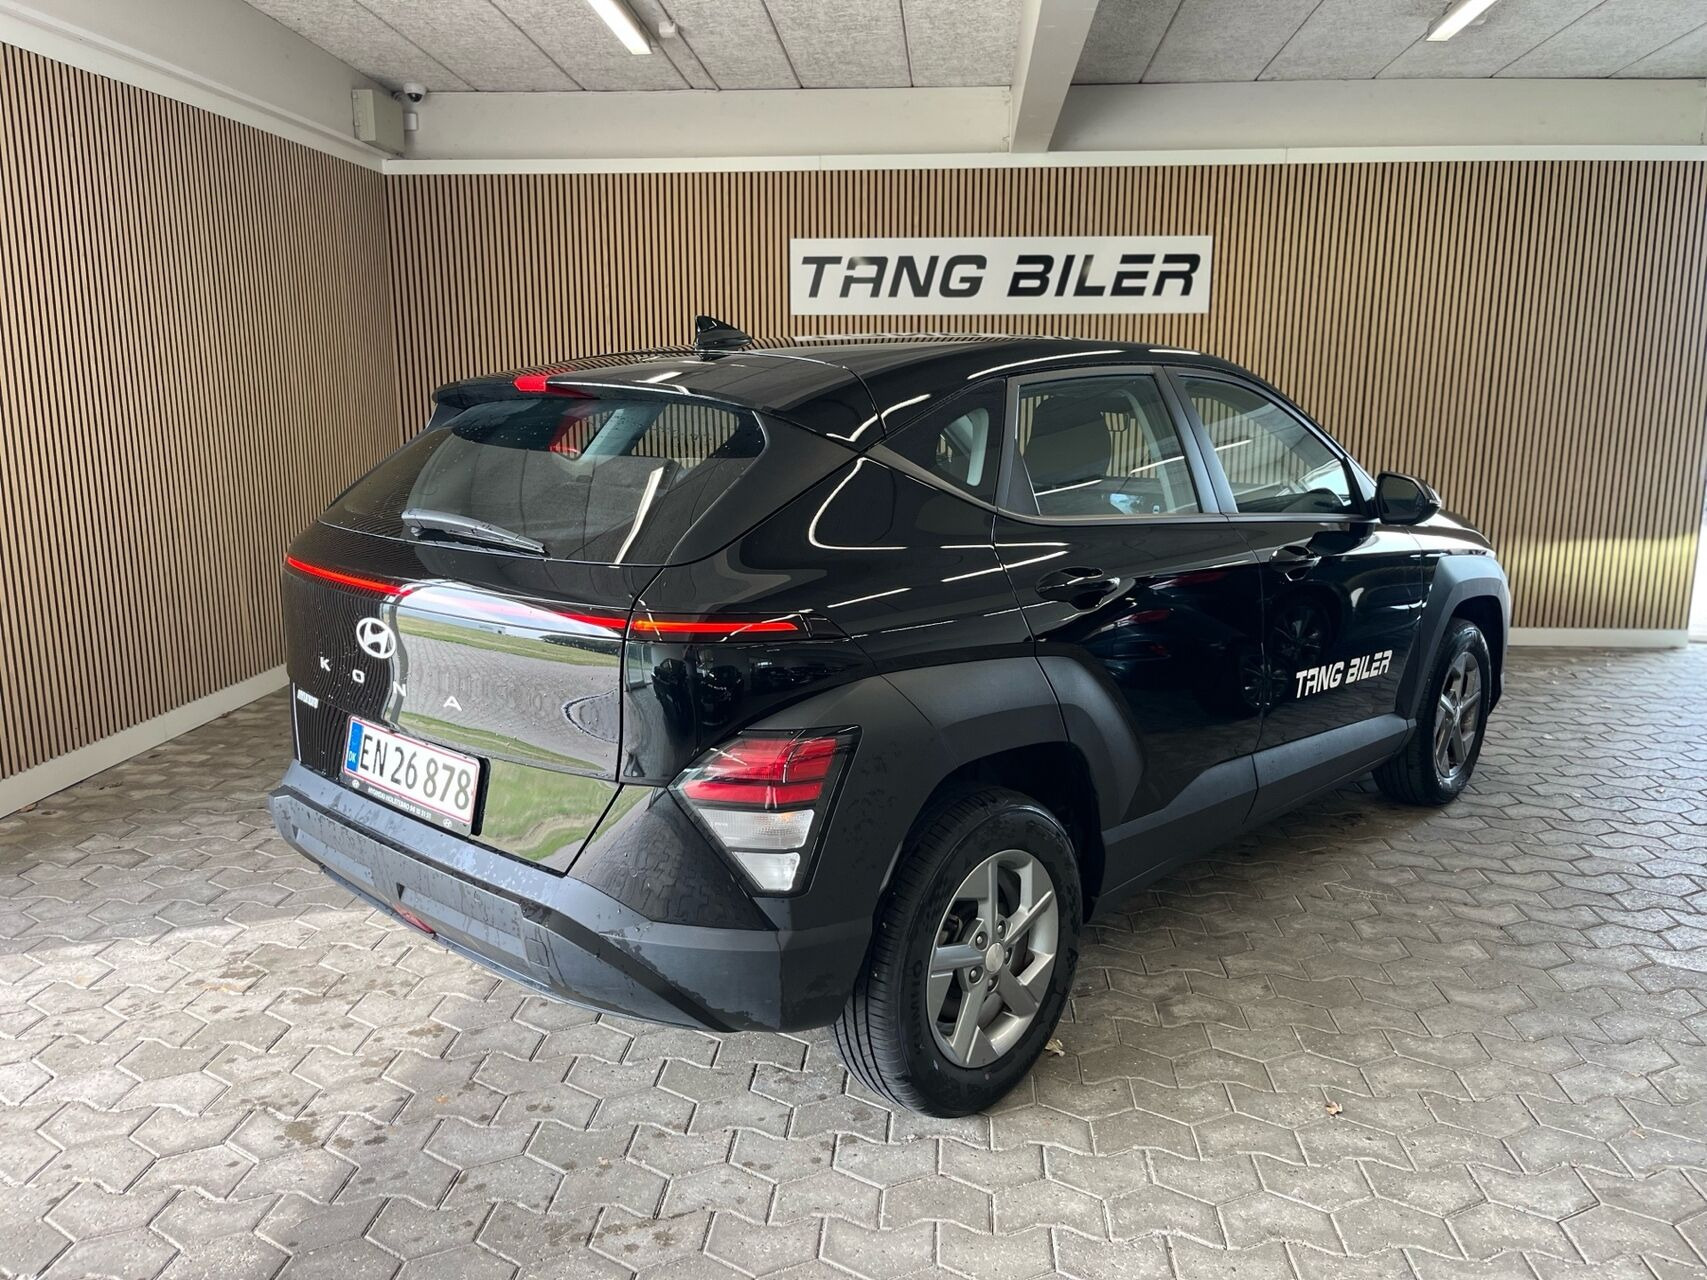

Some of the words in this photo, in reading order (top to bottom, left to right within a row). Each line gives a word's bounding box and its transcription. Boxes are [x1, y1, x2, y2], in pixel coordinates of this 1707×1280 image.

[801, 254, 988, 298] TANG
[1006, 253, 1201, 298] BILER
[1295, 661, 1345, 699] TANG
[1345, 649, 1393, 684] BILER
[348, 750, 357, 763] DK
[360, 733, 388, 777] EN
[390, 746, 418, 790] 26
[423, 757, 471, 810] 878
